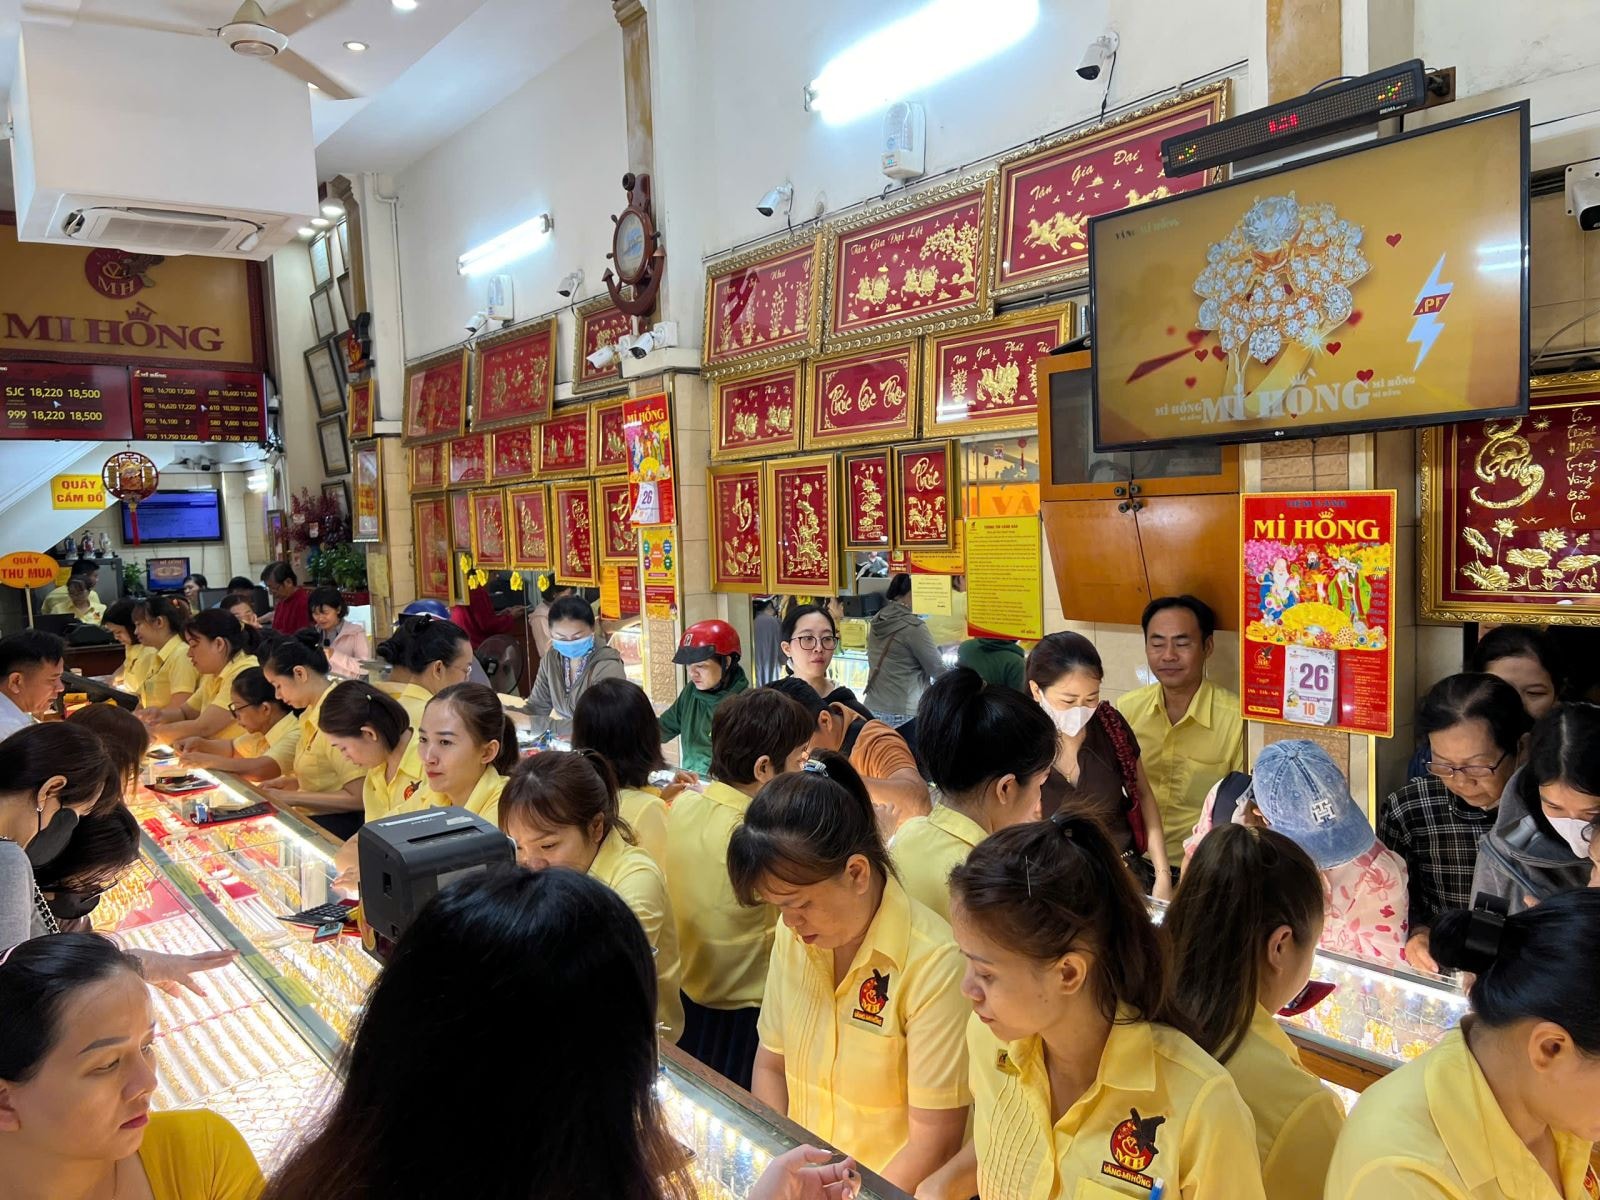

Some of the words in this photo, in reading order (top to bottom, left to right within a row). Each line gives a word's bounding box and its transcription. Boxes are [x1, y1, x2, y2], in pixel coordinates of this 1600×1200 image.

[1071, 164, 1094, 186] Gia
[1113, 149, 1140, 166] Đại
[98, 275, 135, 296] MH
[85, 301, 224, 352] HỒNG
[976, 346, 991, 361] Gia
[5, 387, 25, 396] SJC
[29, 387, 63, 398] 18,220
[67, 389, 101, 399] 18,500
[1256, 367, 1371, 418] HỒNG
[7, 410, 27, 419] 999
[31, 410, 65, 421] 18,220
[70, 411, 102, 422] 18,500
[642, 489, 653, 505] 26
[1294, 508, 1380, 540] HỒNG
[1, 568, 24, 579] THU
[28, 567, 53, 578] MUA
[1299, 663, 1329, 691] 26
[1303, 702, 1315, 715] 10
[1115, 1147, 1146, 1169] MH
